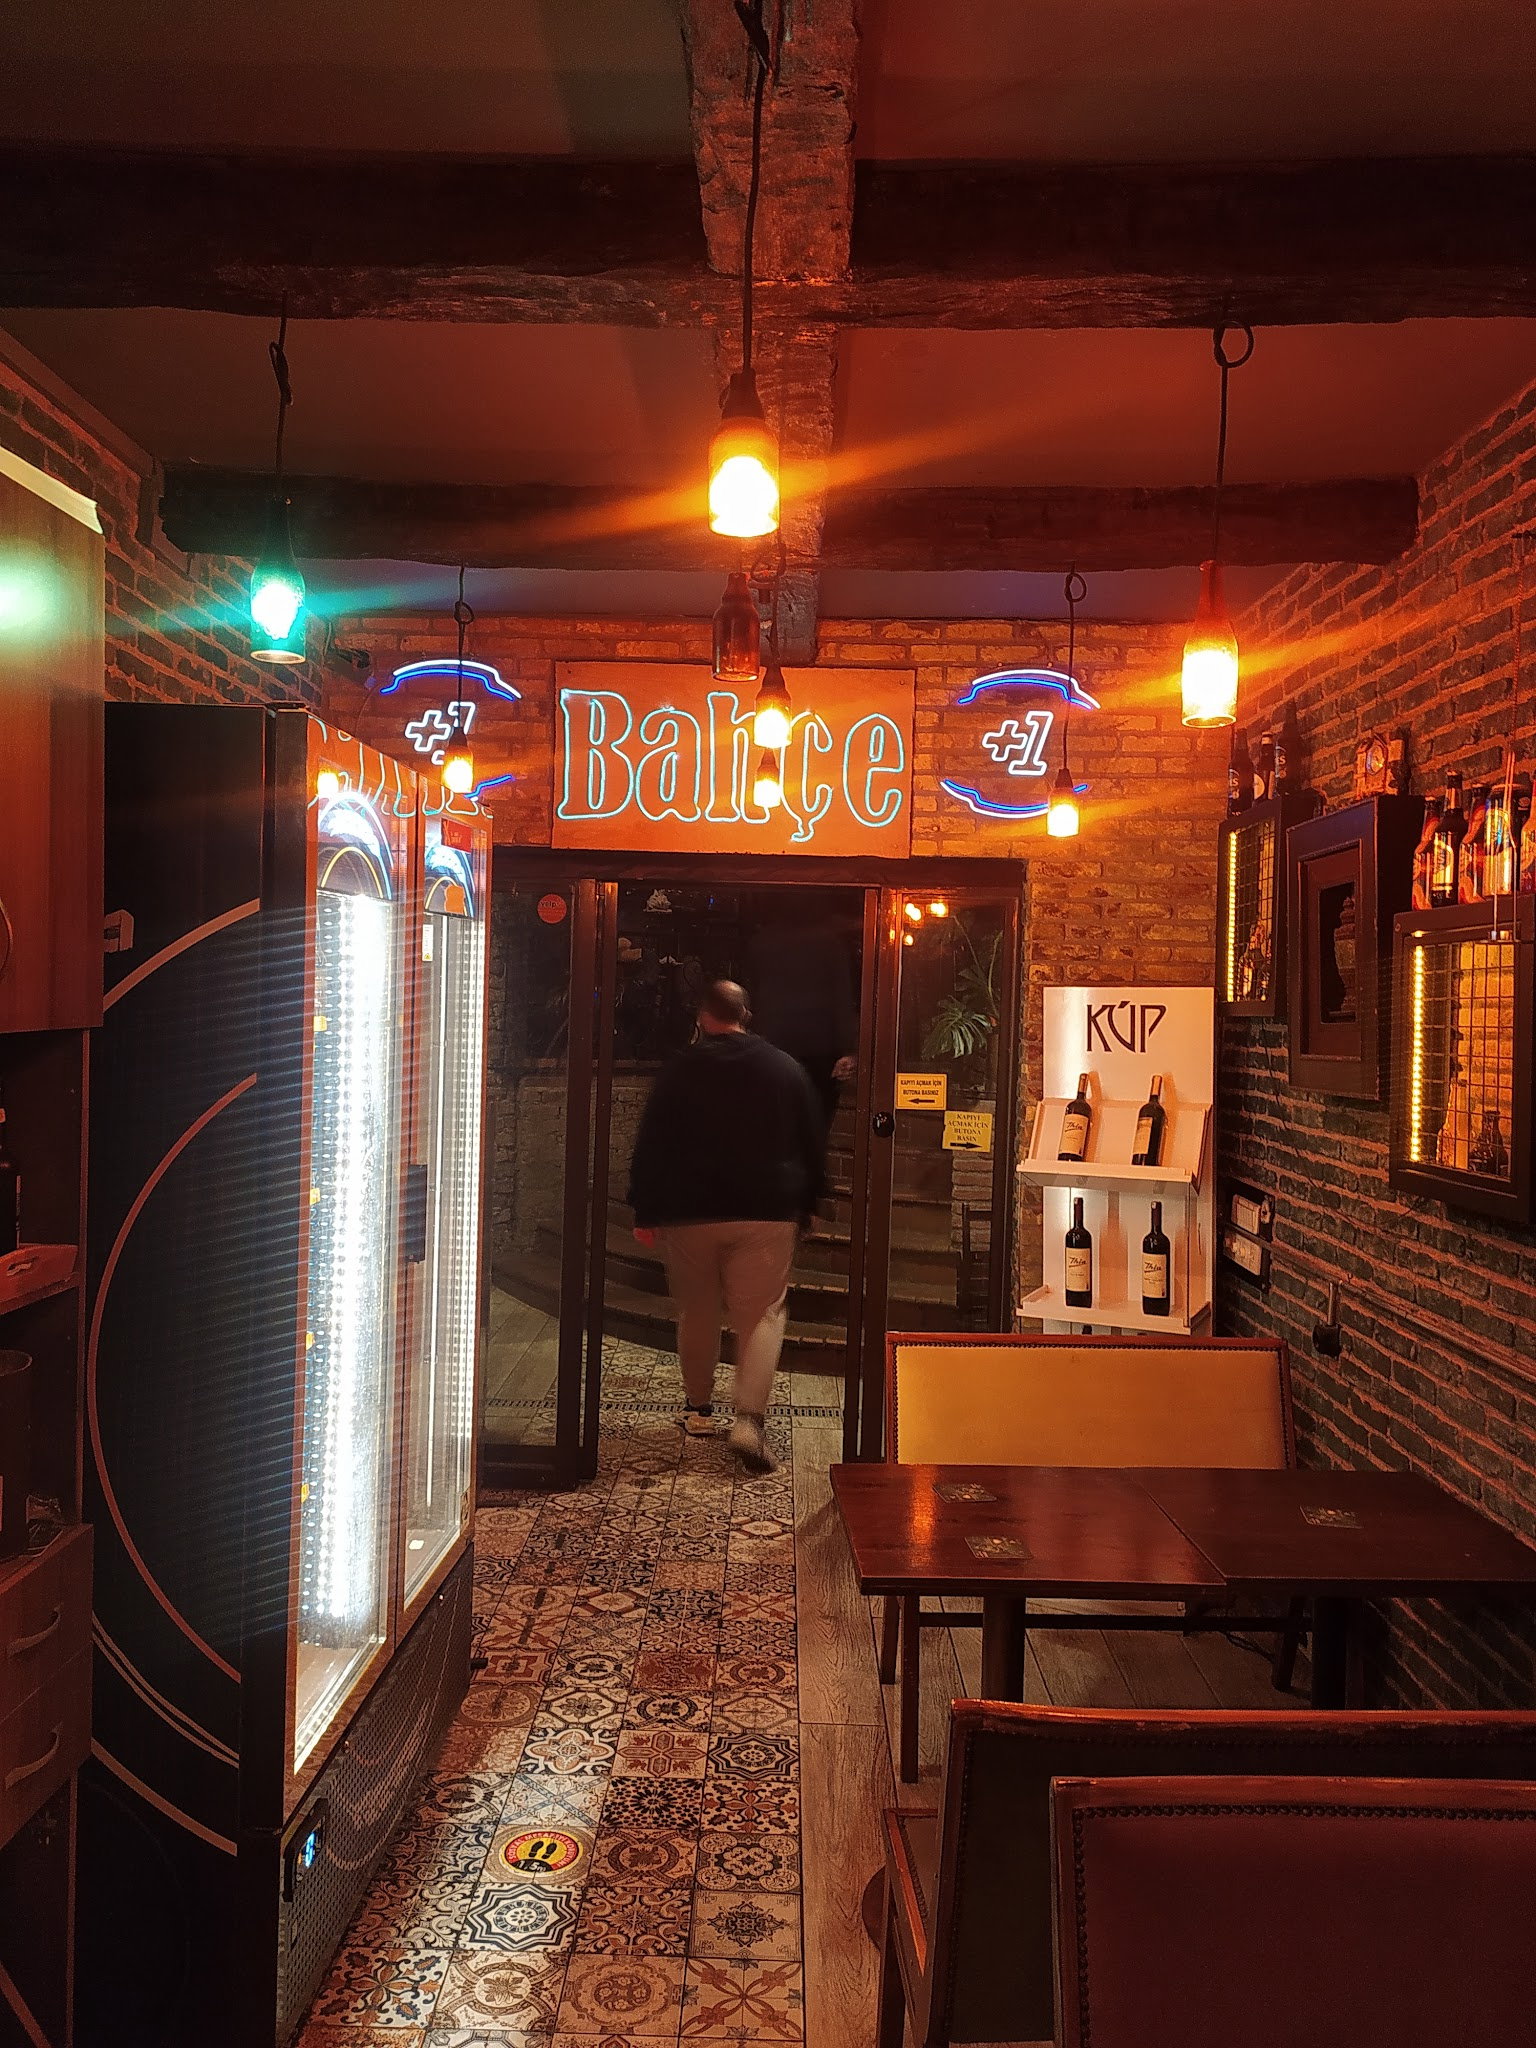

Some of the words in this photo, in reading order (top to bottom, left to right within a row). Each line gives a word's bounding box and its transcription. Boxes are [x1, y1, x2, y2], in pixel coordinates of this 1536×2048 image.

[404, 701, 476, 765] +1
[557, 688, 904, 842] Bahçe
[982, 710, 1054, 776] +1
[948, 1120, 973, 1128] AÇMAK
